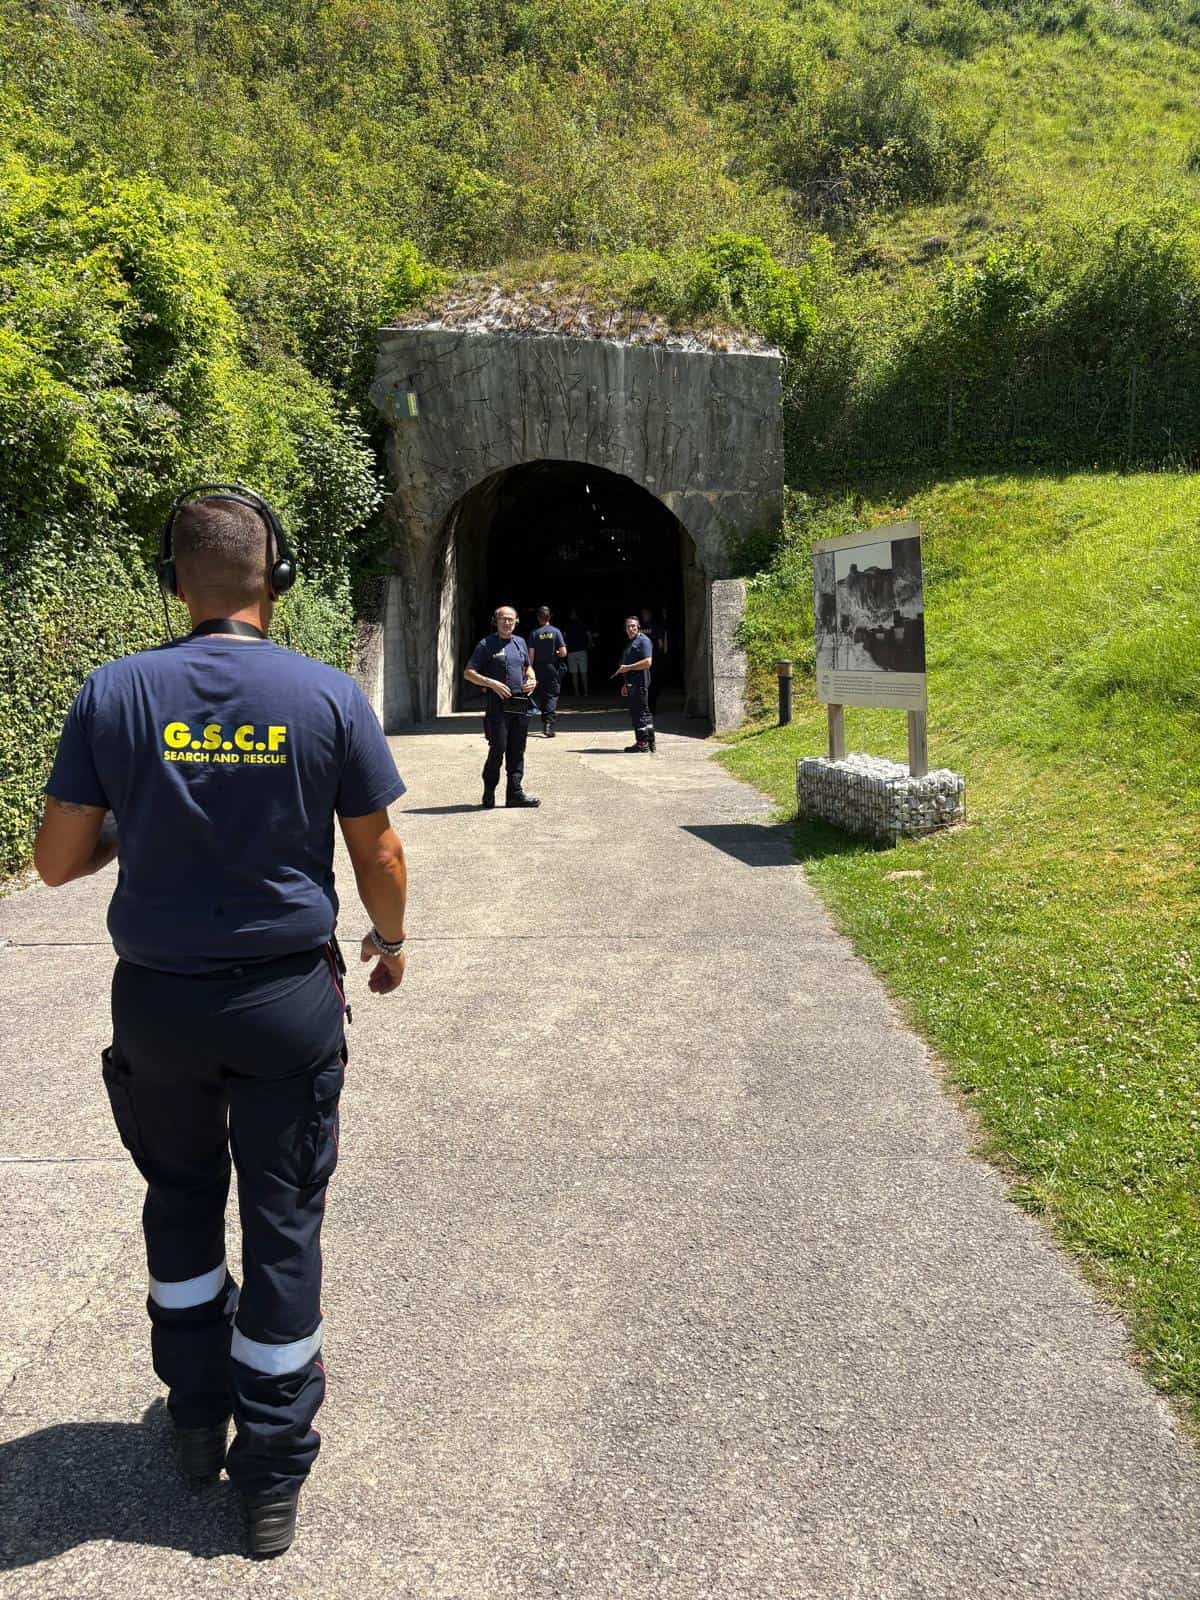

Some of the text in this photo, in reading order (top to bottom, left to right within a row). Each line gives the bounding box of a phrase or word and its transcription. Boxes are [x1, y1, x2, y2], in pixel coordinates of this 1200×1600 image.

[163, 721, 287, 751] G.S.C.F
[163, 751, 287, 764] SEARCH AND RESCUE
